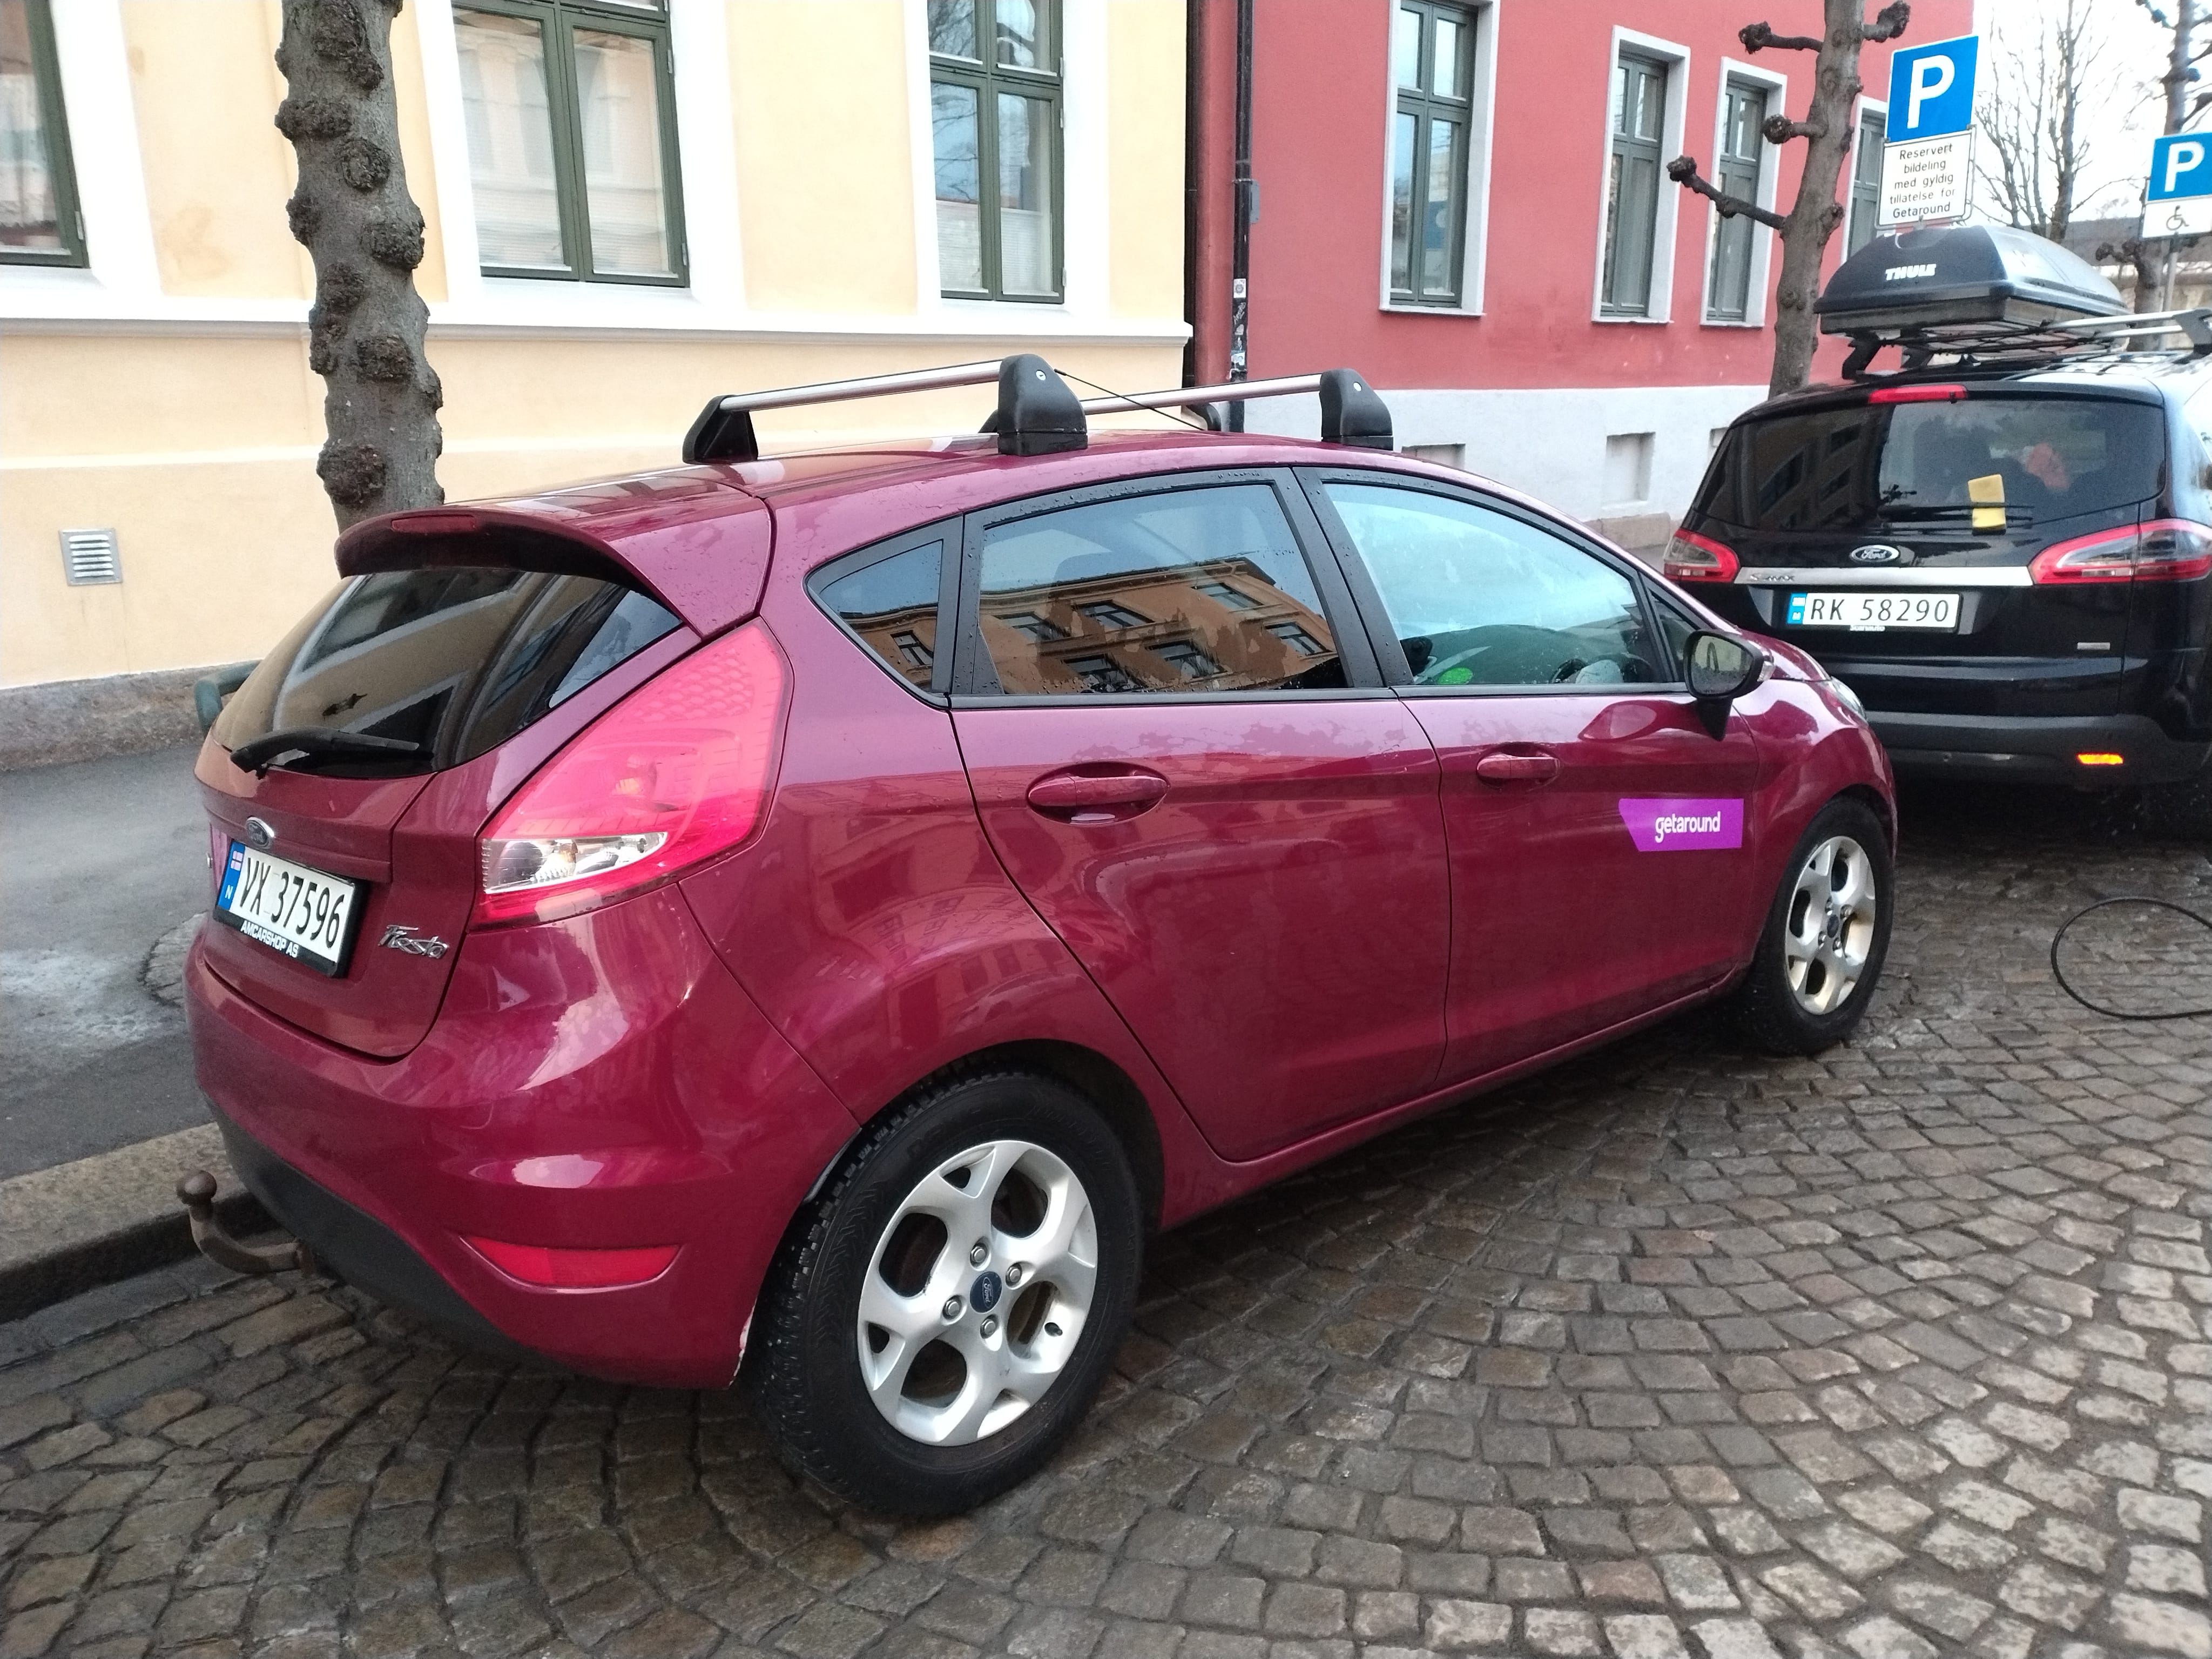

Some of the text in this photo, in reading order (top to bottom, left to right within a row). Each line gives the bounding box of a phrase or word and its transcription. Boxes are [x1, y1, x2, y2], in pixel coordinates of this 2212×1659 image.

[1907, 55, 1955, 129] P
[1900, 143, 1953, 160] Reservert
[1904, 160, 1946, 173] bildeling
[2164, 141, 2205, 192] P
[1894, 174, 1953, 189] med gyldig
[1890, 188, 1955, 204] tillatelse for
[1893, 202, 1950, 218] Getaround
[1885, 264, 1937, 281] THULE
[1861, 548, 1887, 559] Ford
[1811, 598, 1949, 622] RK 58290
[1655, 811, 1721, 843] getaround
[225, 884, 233, 900] N
[239, 858, 345, 948] VX 37596
[240, 920, 299, 958] AMCARSHOP AS
[983, 1283, 993, 1303] Ford
